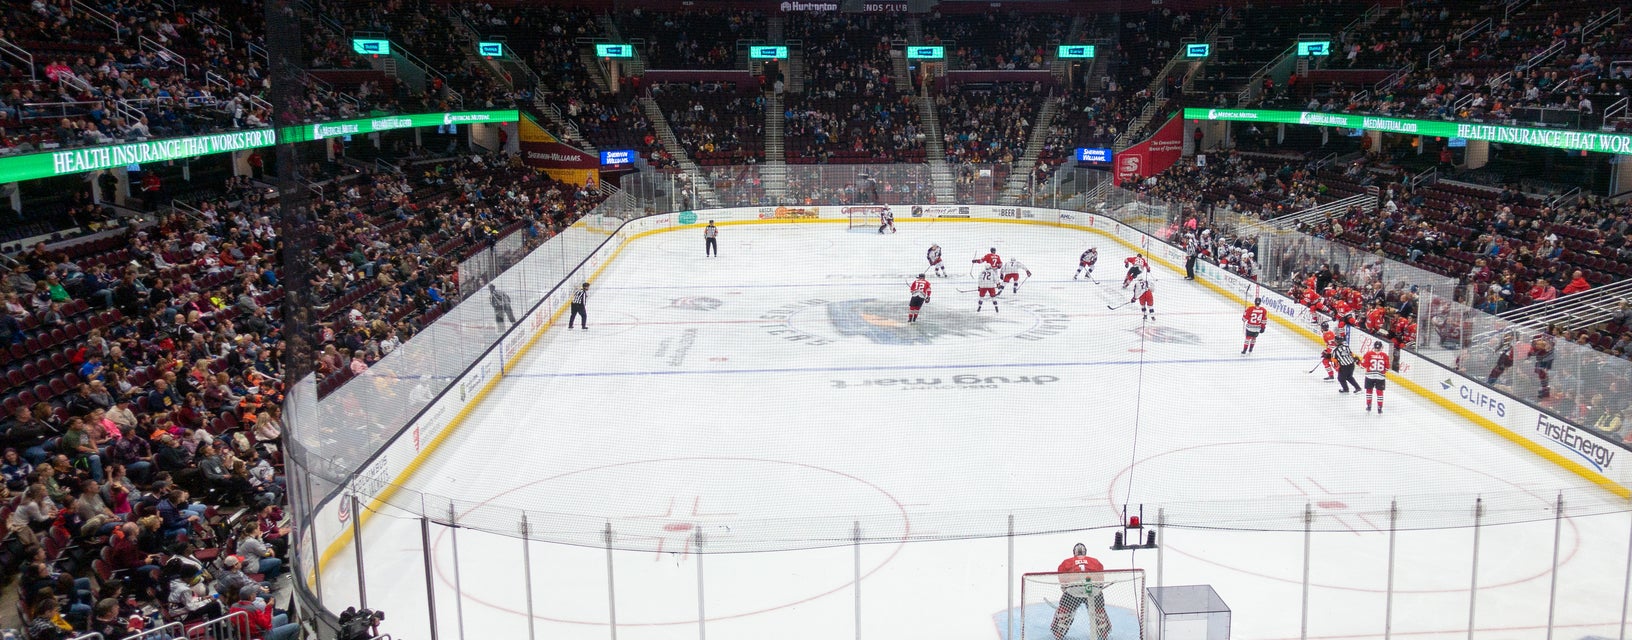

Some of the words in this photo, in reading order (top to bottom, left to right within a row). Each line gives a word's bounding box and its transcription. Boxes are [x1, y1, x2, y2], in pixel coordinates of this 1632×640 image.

[1457, 123, 1496, 141] HEALTH
[1497, 126, 1562, 147] INSURANCE
[1564, 132, 1596, 150] THAT
[1599, 134, 1631, 153] WOR
[53, 147, 111, 174] HEALTH
[113, 141, 181, 167] INSURANCE
[183, 136, 210, 156] THAT
[211, 133, 245, 152] WORKS
[245, 131, 262, 148] FOR
[263, 129, 276, 145] YO
[914, 282, 925, 291] 12
[1262, 295, 1295, 317] GOODYEAR
[1250, 313, 1263, 324] 24
[1369, 359, 1385, 371] 36
[952, 374, 1060, 386] drug
[1460, 385, 1506, 418] CLIFFS
[1536, 413, 1615, 468] FirstEnergy
